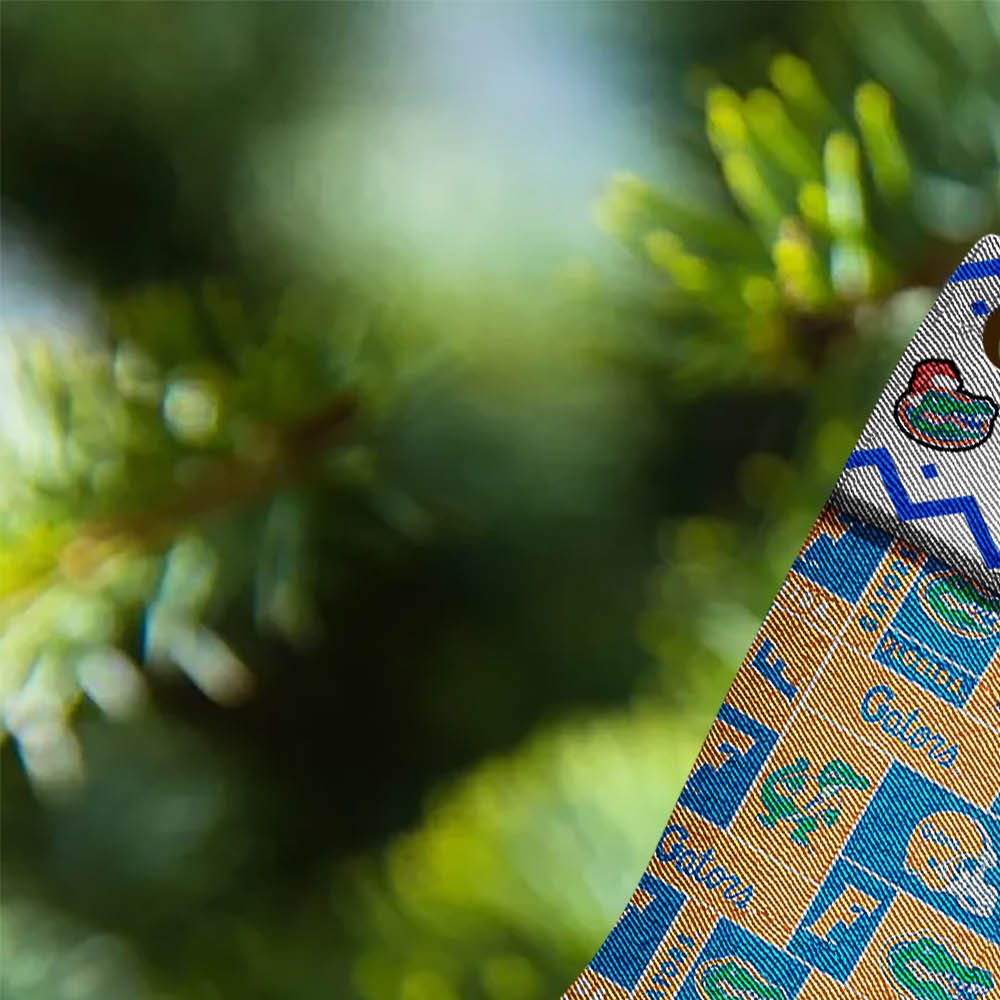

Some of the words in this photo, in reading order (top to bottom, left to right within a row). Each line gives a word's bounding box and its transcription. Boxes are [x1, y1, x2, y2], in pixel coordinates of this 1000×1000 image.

[879, 635, 966, 697] FLORIDA
[861, 686, 957, 768] Gators
[657, 827, 751, 908] Gators
[803, 885, 881, 946] F
